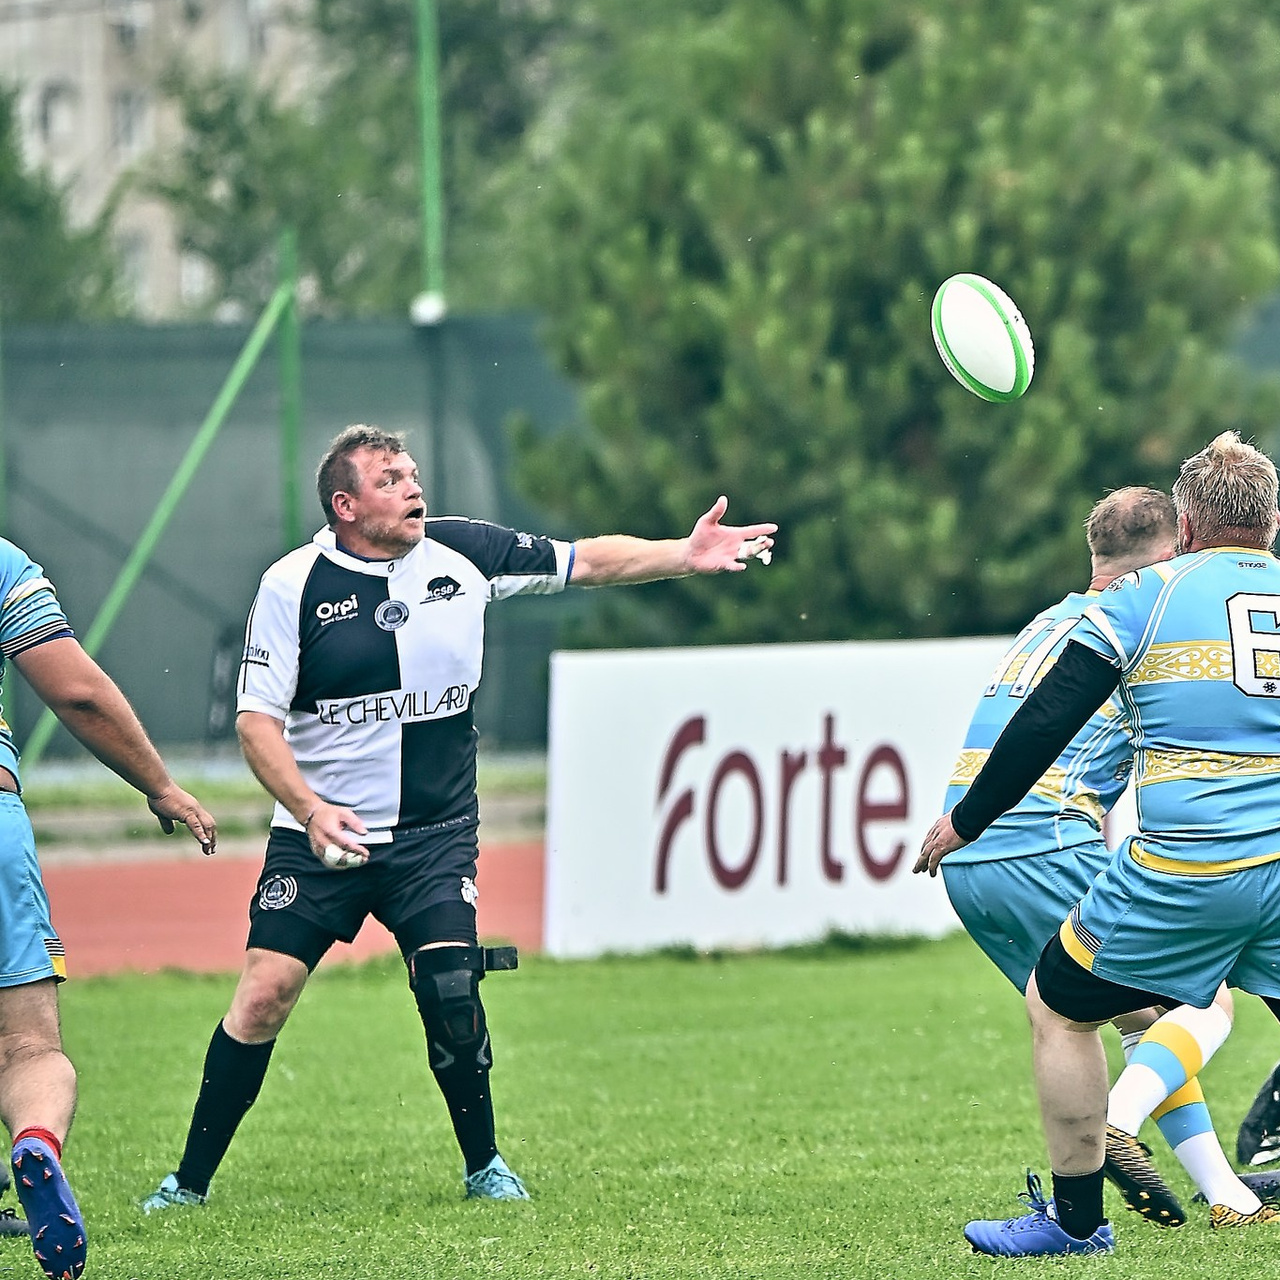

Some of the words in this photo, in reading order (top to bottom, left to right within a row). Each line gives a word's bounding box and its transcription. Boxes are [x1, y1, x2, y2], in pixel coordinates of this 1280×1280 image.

[316, 593, 358, 619] Orpi
[319, 704, 341, 725] LE
[654, 712, 909, 894] Forte
